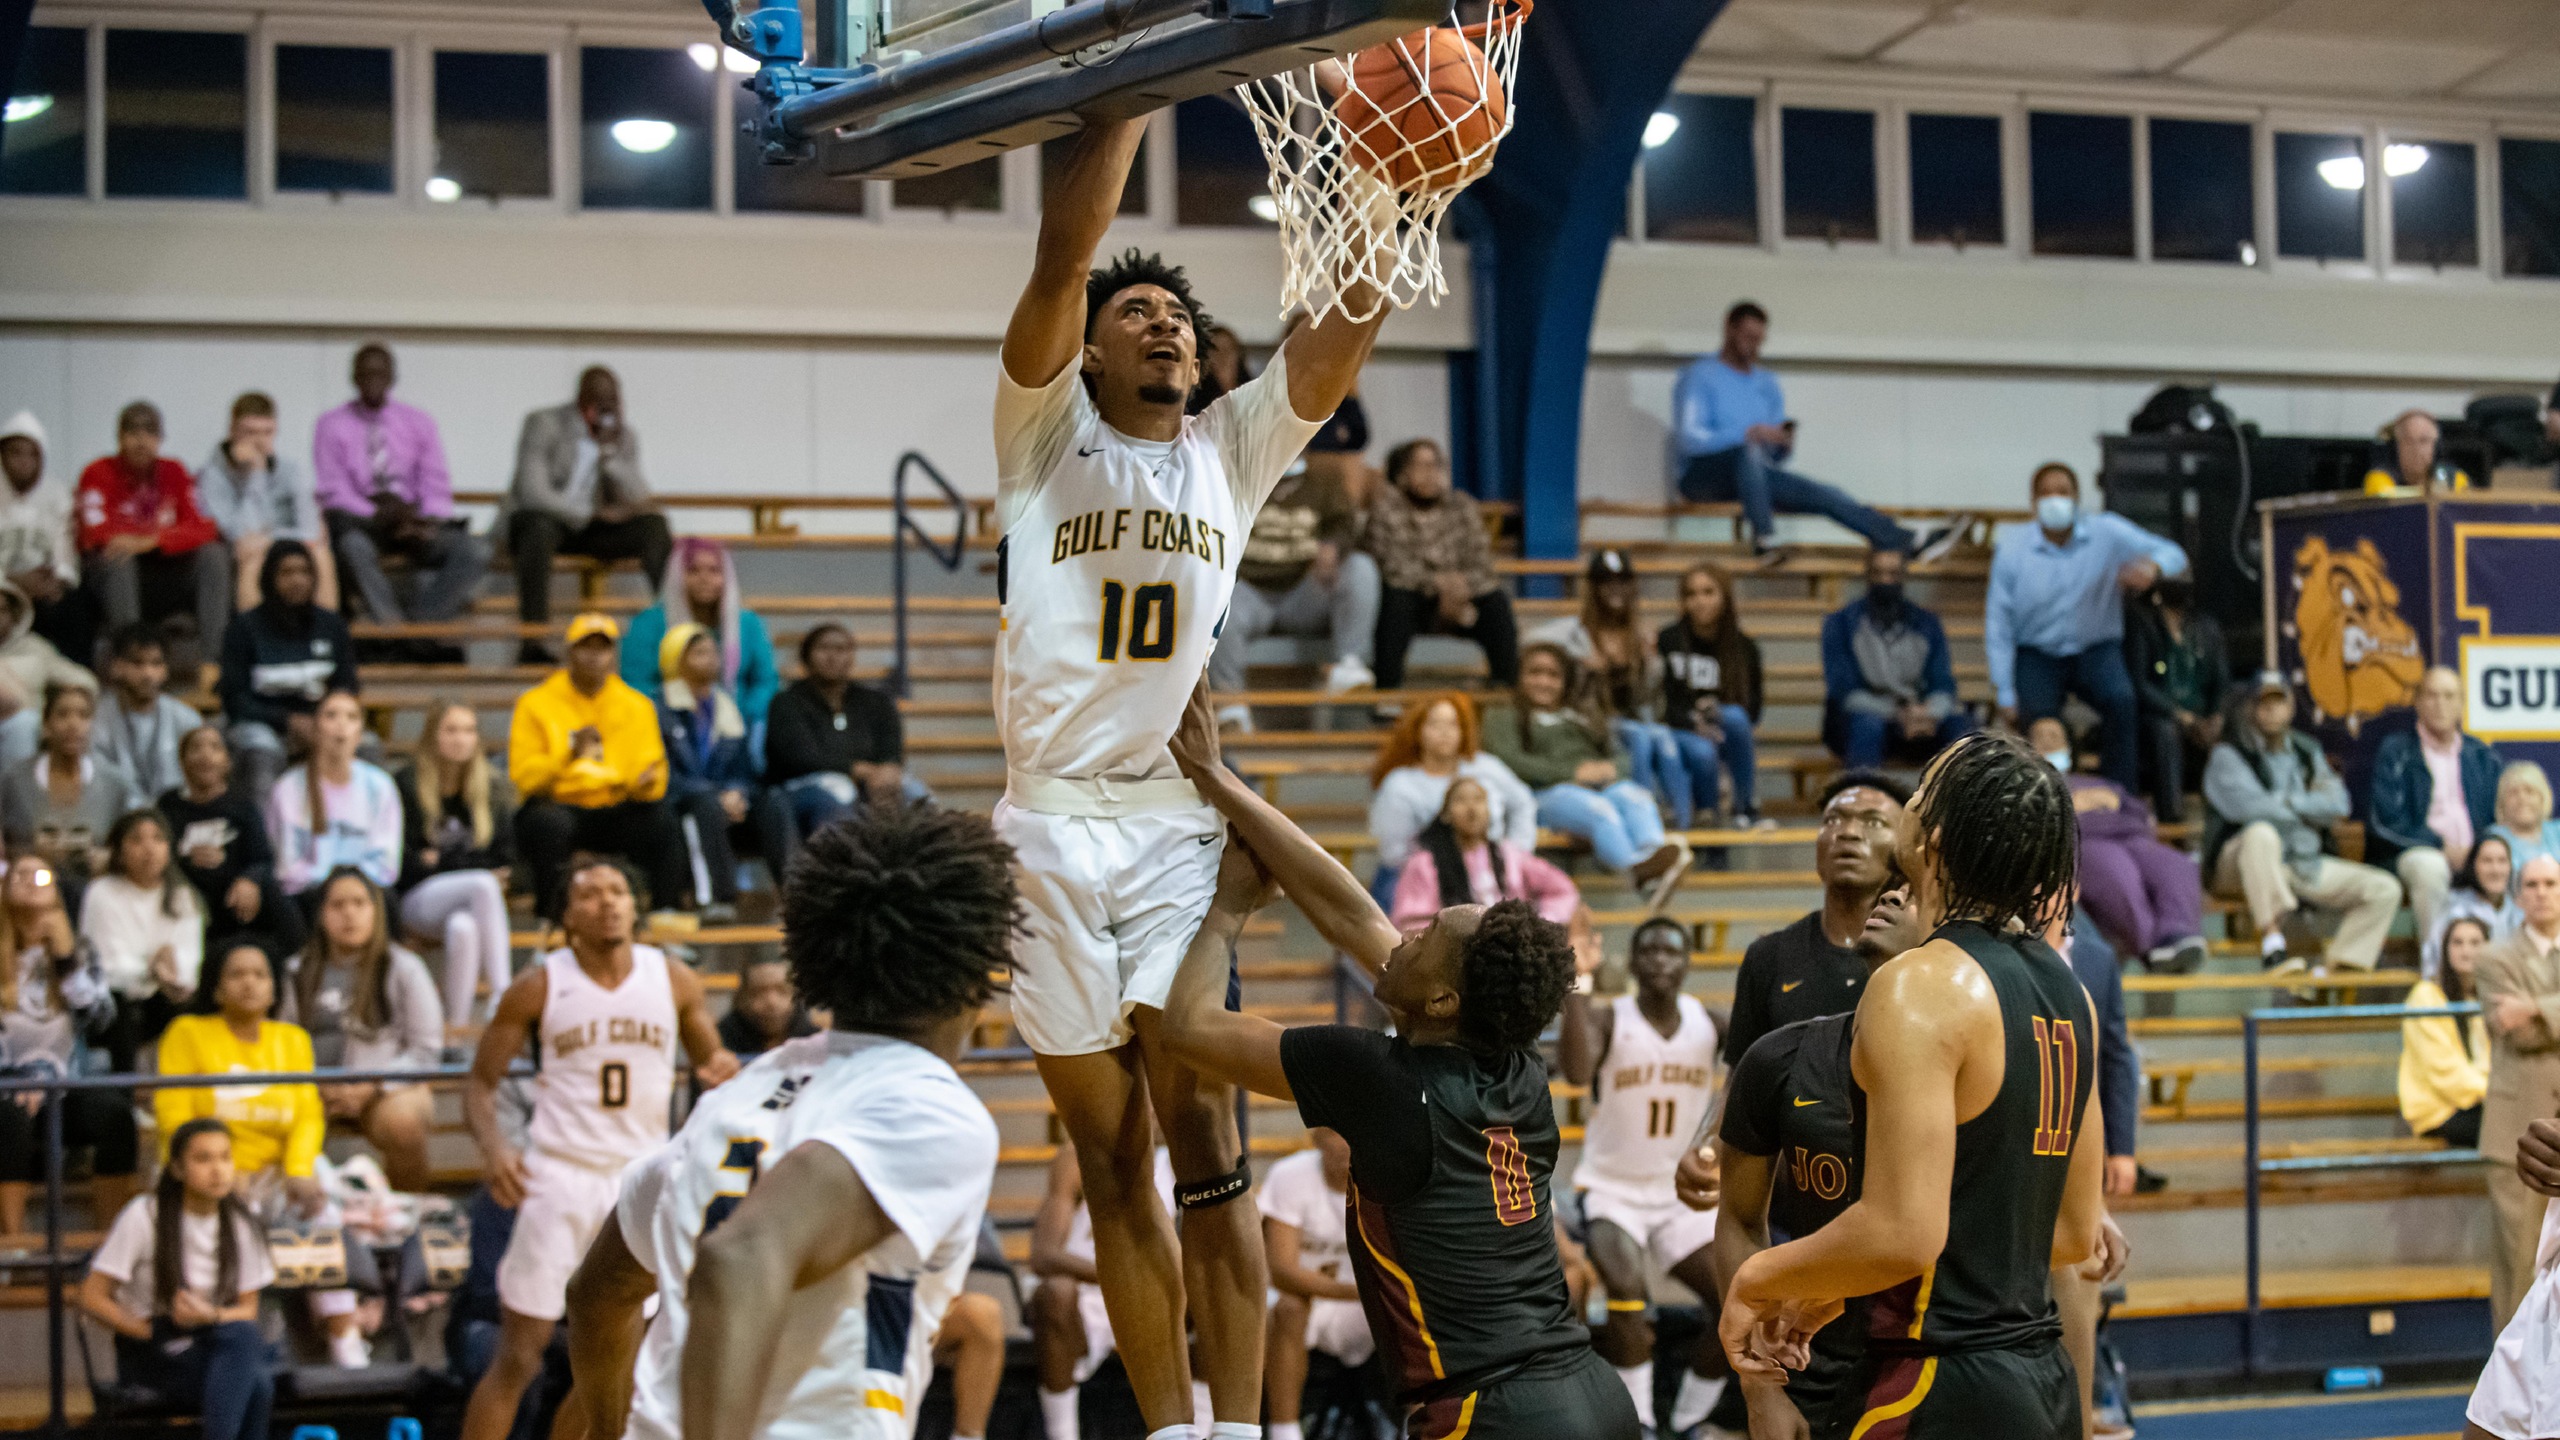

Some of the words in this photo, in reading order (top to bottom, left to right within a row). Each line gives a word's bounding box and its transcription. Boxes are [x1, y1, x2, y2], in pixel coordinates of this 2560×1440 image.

[1052, 508, 1132, 564] GULF
[1141, 509, 1226, 571] COAST
[1097, 578, 1178, 663] 10
[2481, 667, 2560, 710] GU
[599, 1061, 631, 1109] 0
[2031, 1015, 2078, 1156] 11
[1648, 1098, 1675, 1138] 11
[1186, 1179, 1243, 1202] MUELLER
[1481, 1126, 1537, 1227] 0
[1791, 1146, 1853, 1201] JO
